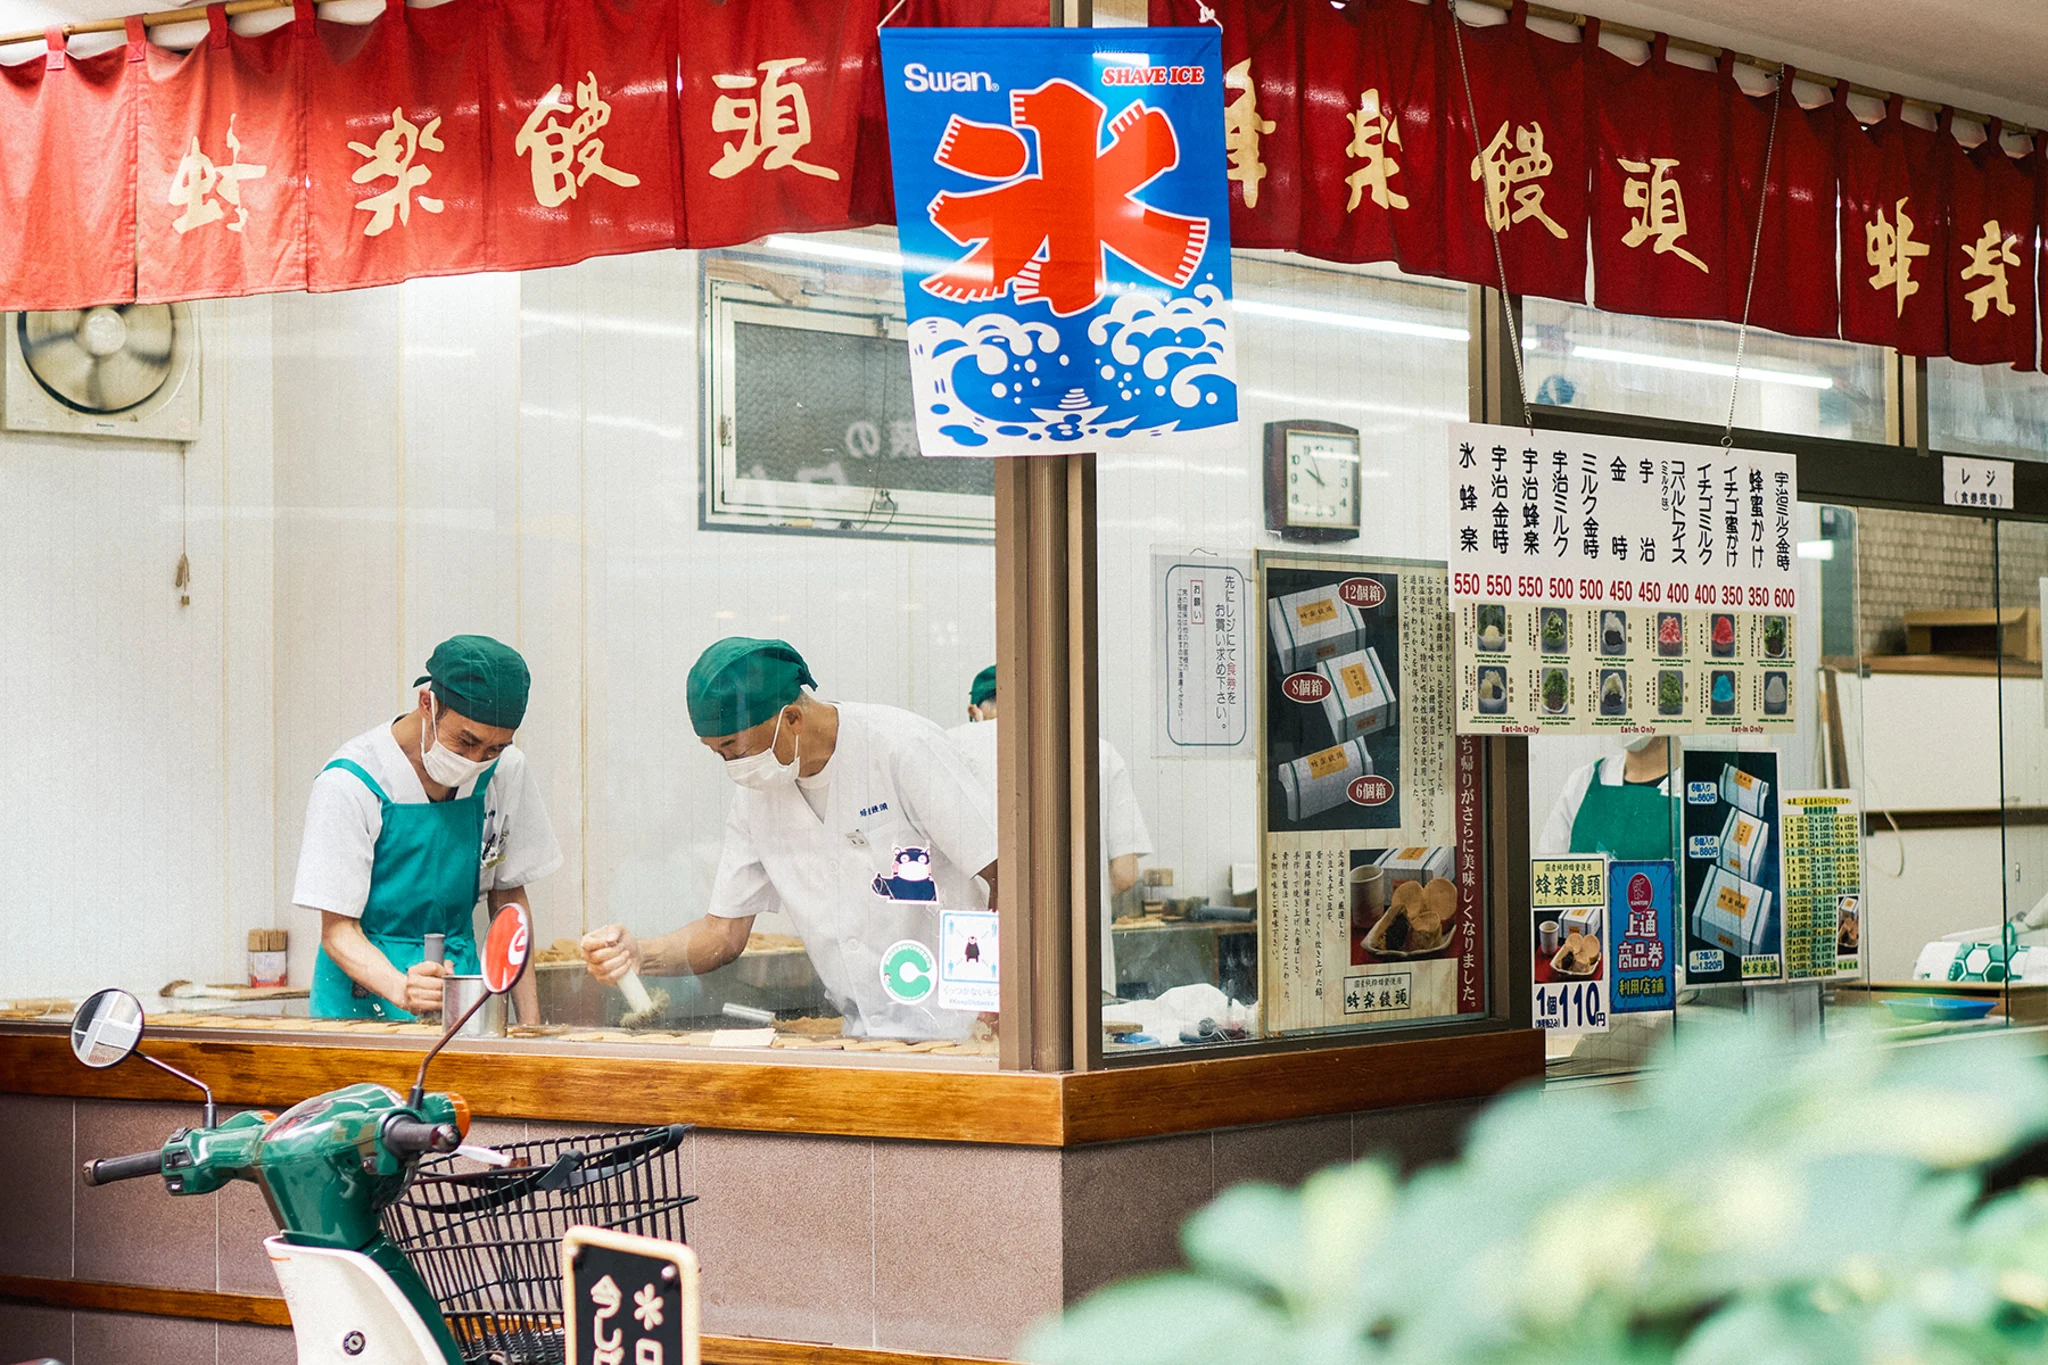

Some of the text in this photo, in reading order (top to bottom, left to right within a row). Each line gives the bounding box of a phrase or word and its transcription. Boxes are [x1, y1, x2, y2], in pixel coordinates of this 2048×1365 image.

[903, 62, 994, 93] Swan
[1101, 65, 1205, 86] SHAVE ICE
[168, 57, 840, 237] 蜂楽饅頭
[919, 77, 1210, 318] 氷
[1866, 195, 2021, 325] 蜂楽
[1459, 442, 1479, 553] 氷蜂楽
[1491, 444, 1509, 554] 宇治金時
[1522, 447, 1540, 555] 宇治蜂楽
[1552, 450, 1569, 558] 宇治ミルク
[1581, 452, 1599, 559] ミルク金時
[1610, 456, 1628, 561] 金時
[1639, 458, 1655, 562] 宇治
[1670, 459, 1687, 564] コバルトアイス
[1697, 463, 1713, 565] イチゴミルク
[1749, 468, 1764, 568] 蜂蜜かけ
[1774, 471, 1791, 571] 宇治ミルク金時
[1960, 467, 1996, 488] レジ
[1225, 575, 1237, 705] 先にレジにて食券を
[1344, 583, 1381, 602] 12個箱
[1454, 572, 1795, 608] 550 550 550 500 500 450 450 400 400 350 350 600
[1214, 604, 1227, 730] お買い求め下さい。
[1291, 678, 1323, 697] 8個箱
[1750, 726, 1764, 734] Only
[1355, 782, 1387, 801] 6個箱
[1460, 735, 1477, 1008] ち帰りがさらに美味しくなりました。
[1535, 873, 1602, 897] 蜂楽饅頭
[1618, 942, 1663, 969] 商品券
[1624, 910, 1657, 937] 上通
[1618, 977, 1665, 996] 利用店舗
